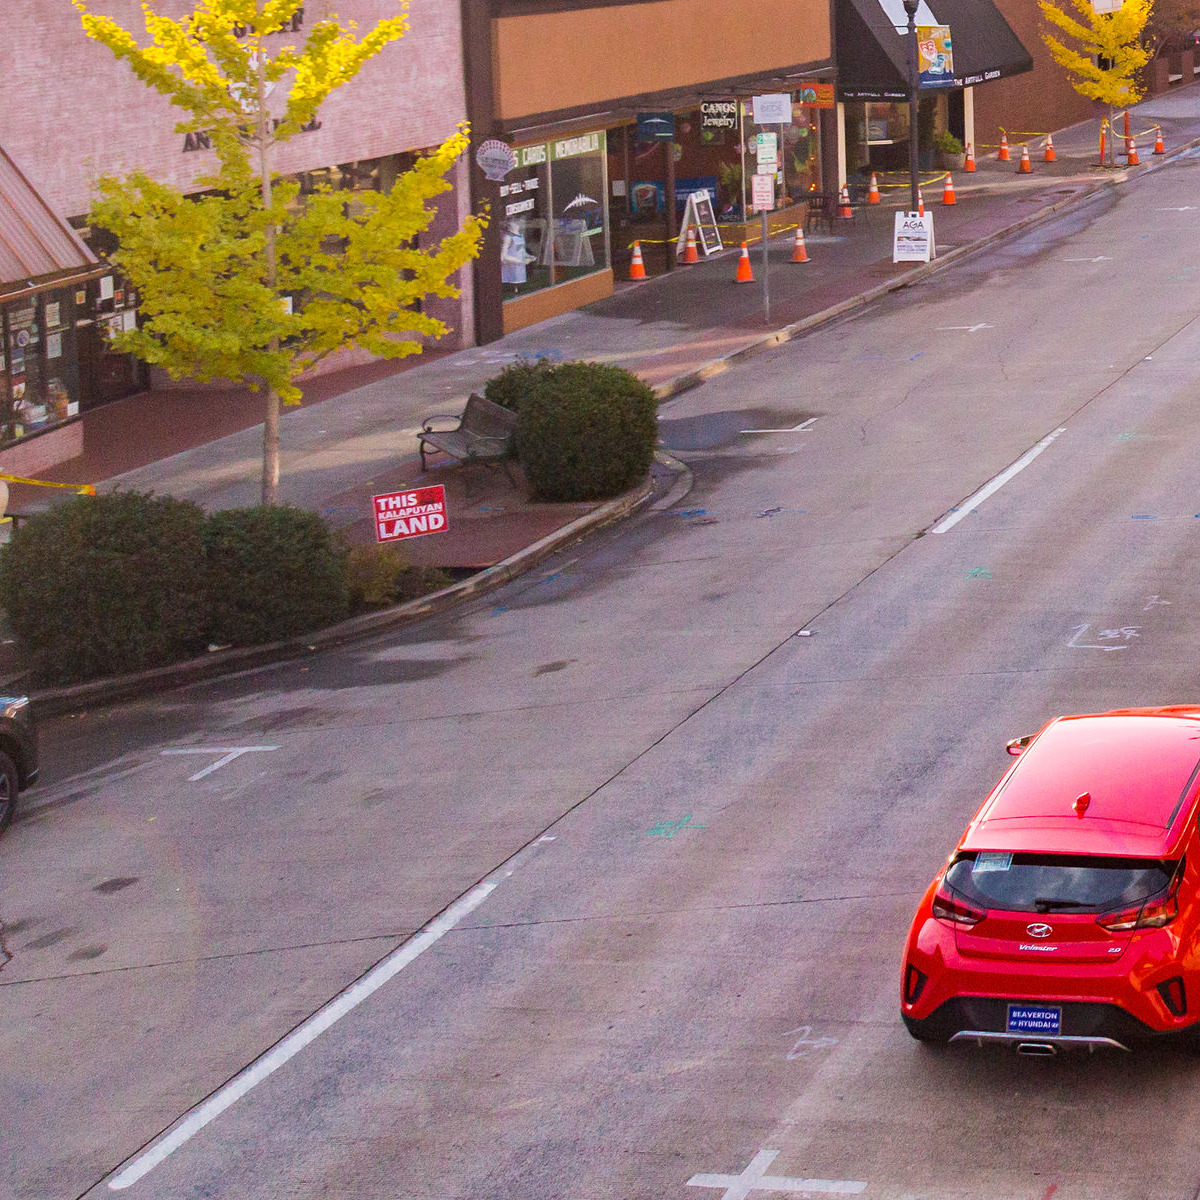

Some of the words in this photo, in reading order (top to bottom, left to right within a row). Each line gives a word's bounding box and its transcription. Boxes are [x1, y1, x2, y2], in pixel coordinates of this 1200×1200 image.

[701, 103, 736, 114] CANOS
[703, 116, 734, 128] Jewelry
[903, 221, 924, 229] AGA
[376, 493, 418, 511] THIS
[378, 502, 443, 520] KALAPUYAN
[379, 513, 445, 539] LAND
[1019, 944, 1058, 952] Veloster
[1012, 1010, 1058, 1019] BEAVERTON
[1018, 1020, 1051, 1028] HYUNDAI
